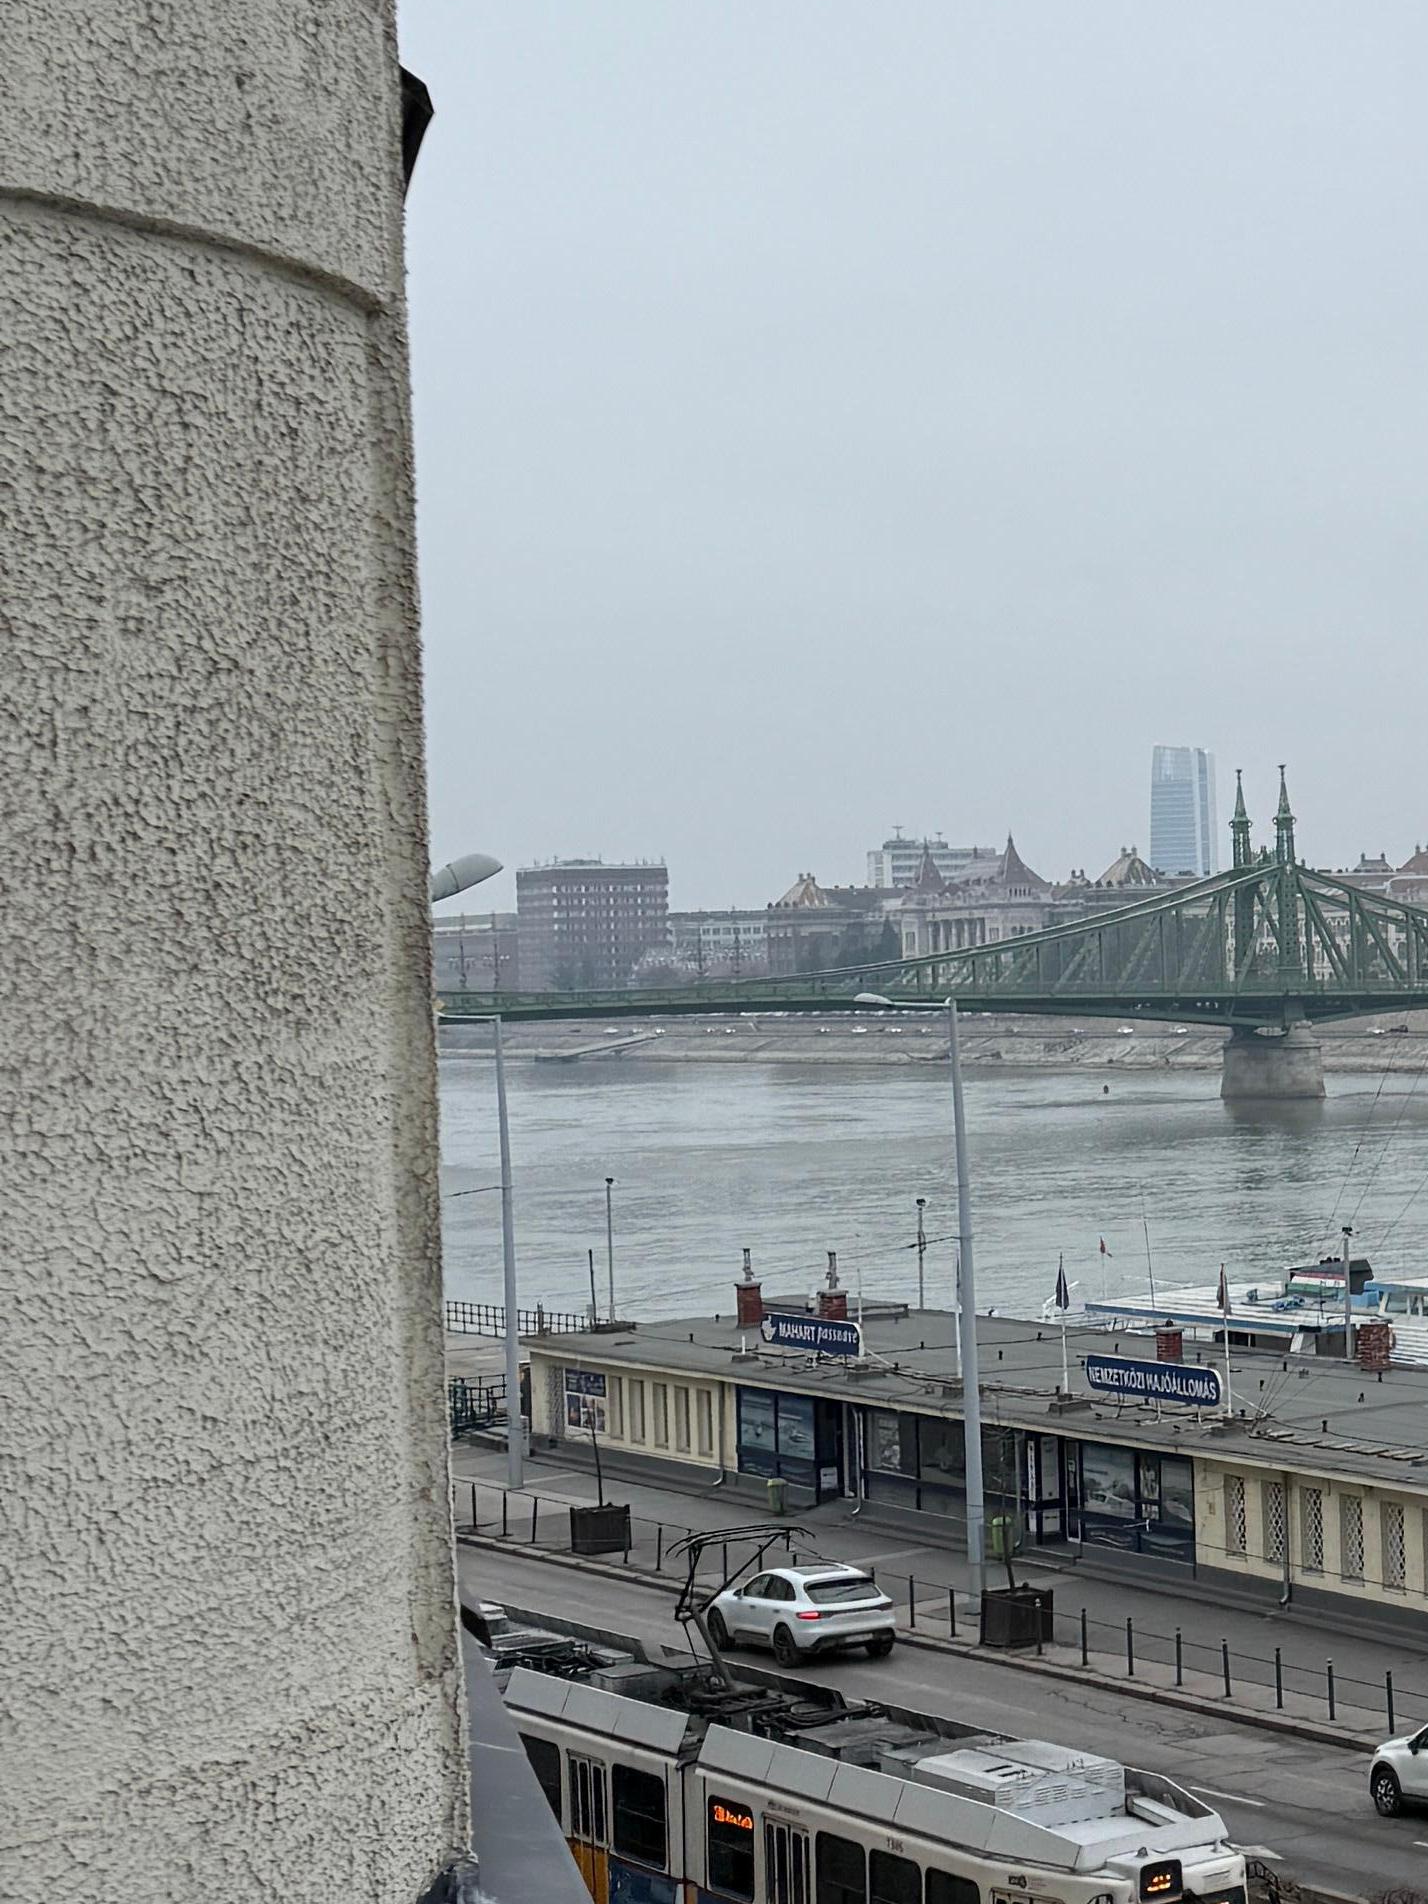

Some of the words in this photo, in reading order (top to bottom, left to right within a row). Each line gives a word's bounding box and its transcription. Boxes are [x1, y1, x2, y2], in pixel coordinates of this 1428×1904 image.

[778, 1321, 817, 1342] MAHART
[1088, 1366, 1145, 1389] NEMZETKÖZI
[1146, 1371, 1217, 1400] HAJÓÁLLOMÁS
